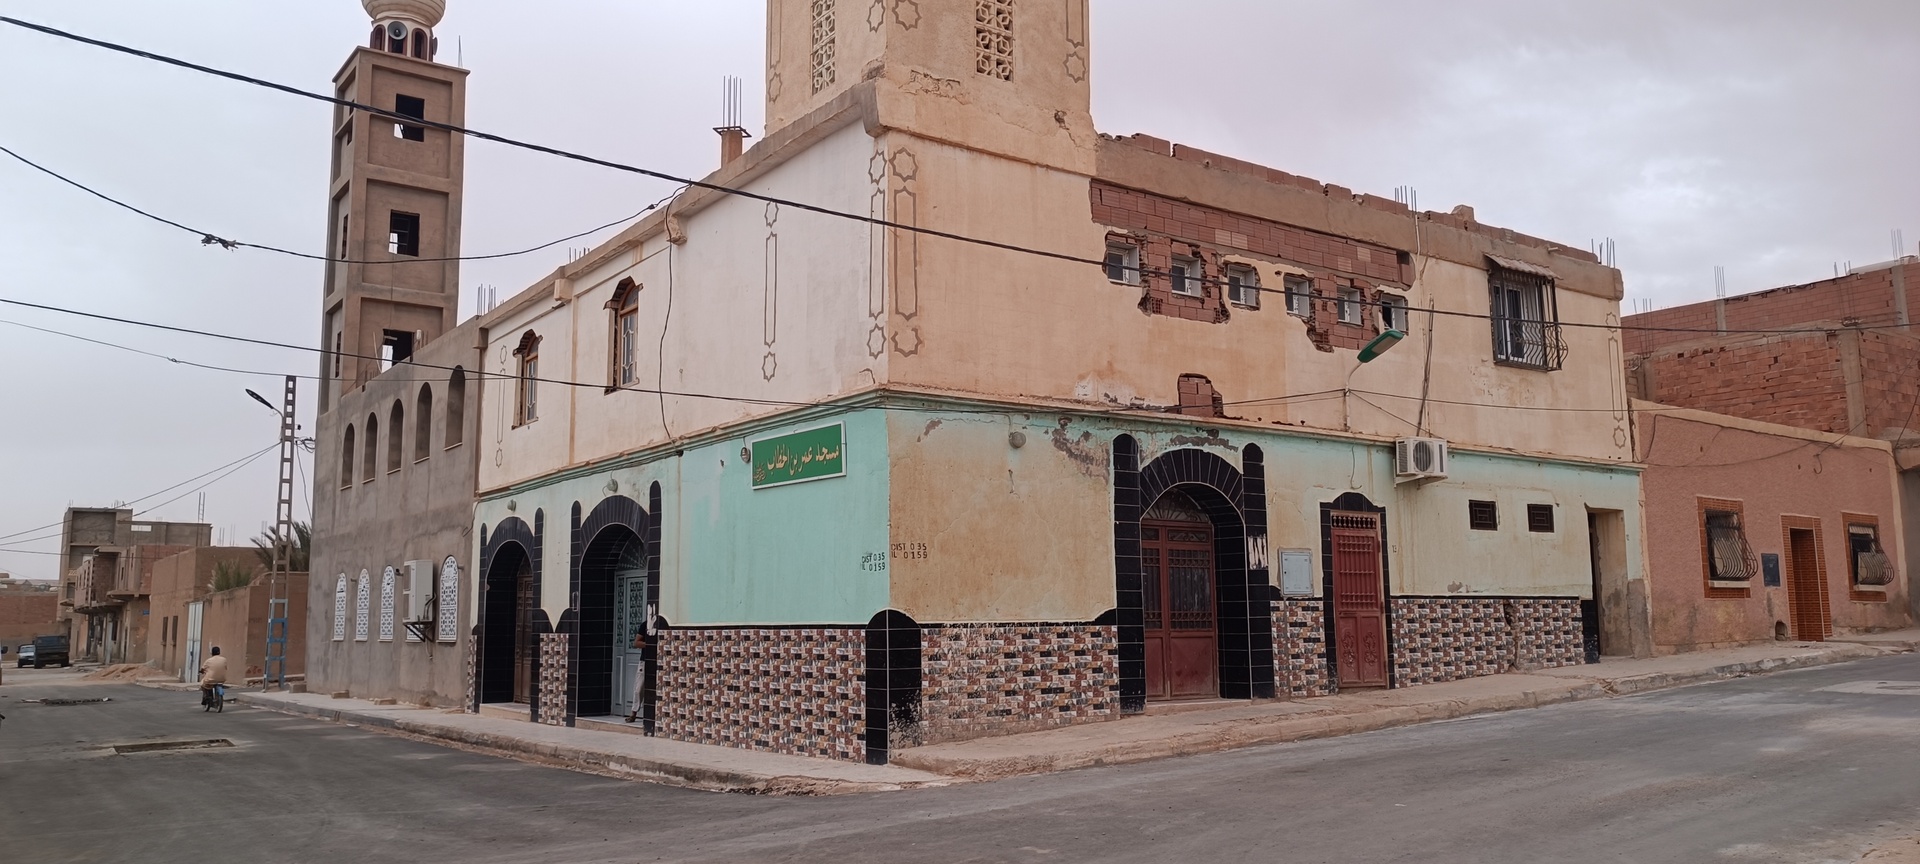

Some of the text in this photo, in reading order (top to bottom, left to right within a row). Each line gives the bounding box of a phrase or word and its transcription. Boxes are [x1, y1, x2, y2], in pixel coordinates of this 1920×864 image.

[766, 443, 789, 475] الخطاب
[789, 453, 798, 476] بن
[798, 446, 813, 472] عمر
[815, 443, 839, 465] مسجد
[868, 562, 886, 571] 0159
